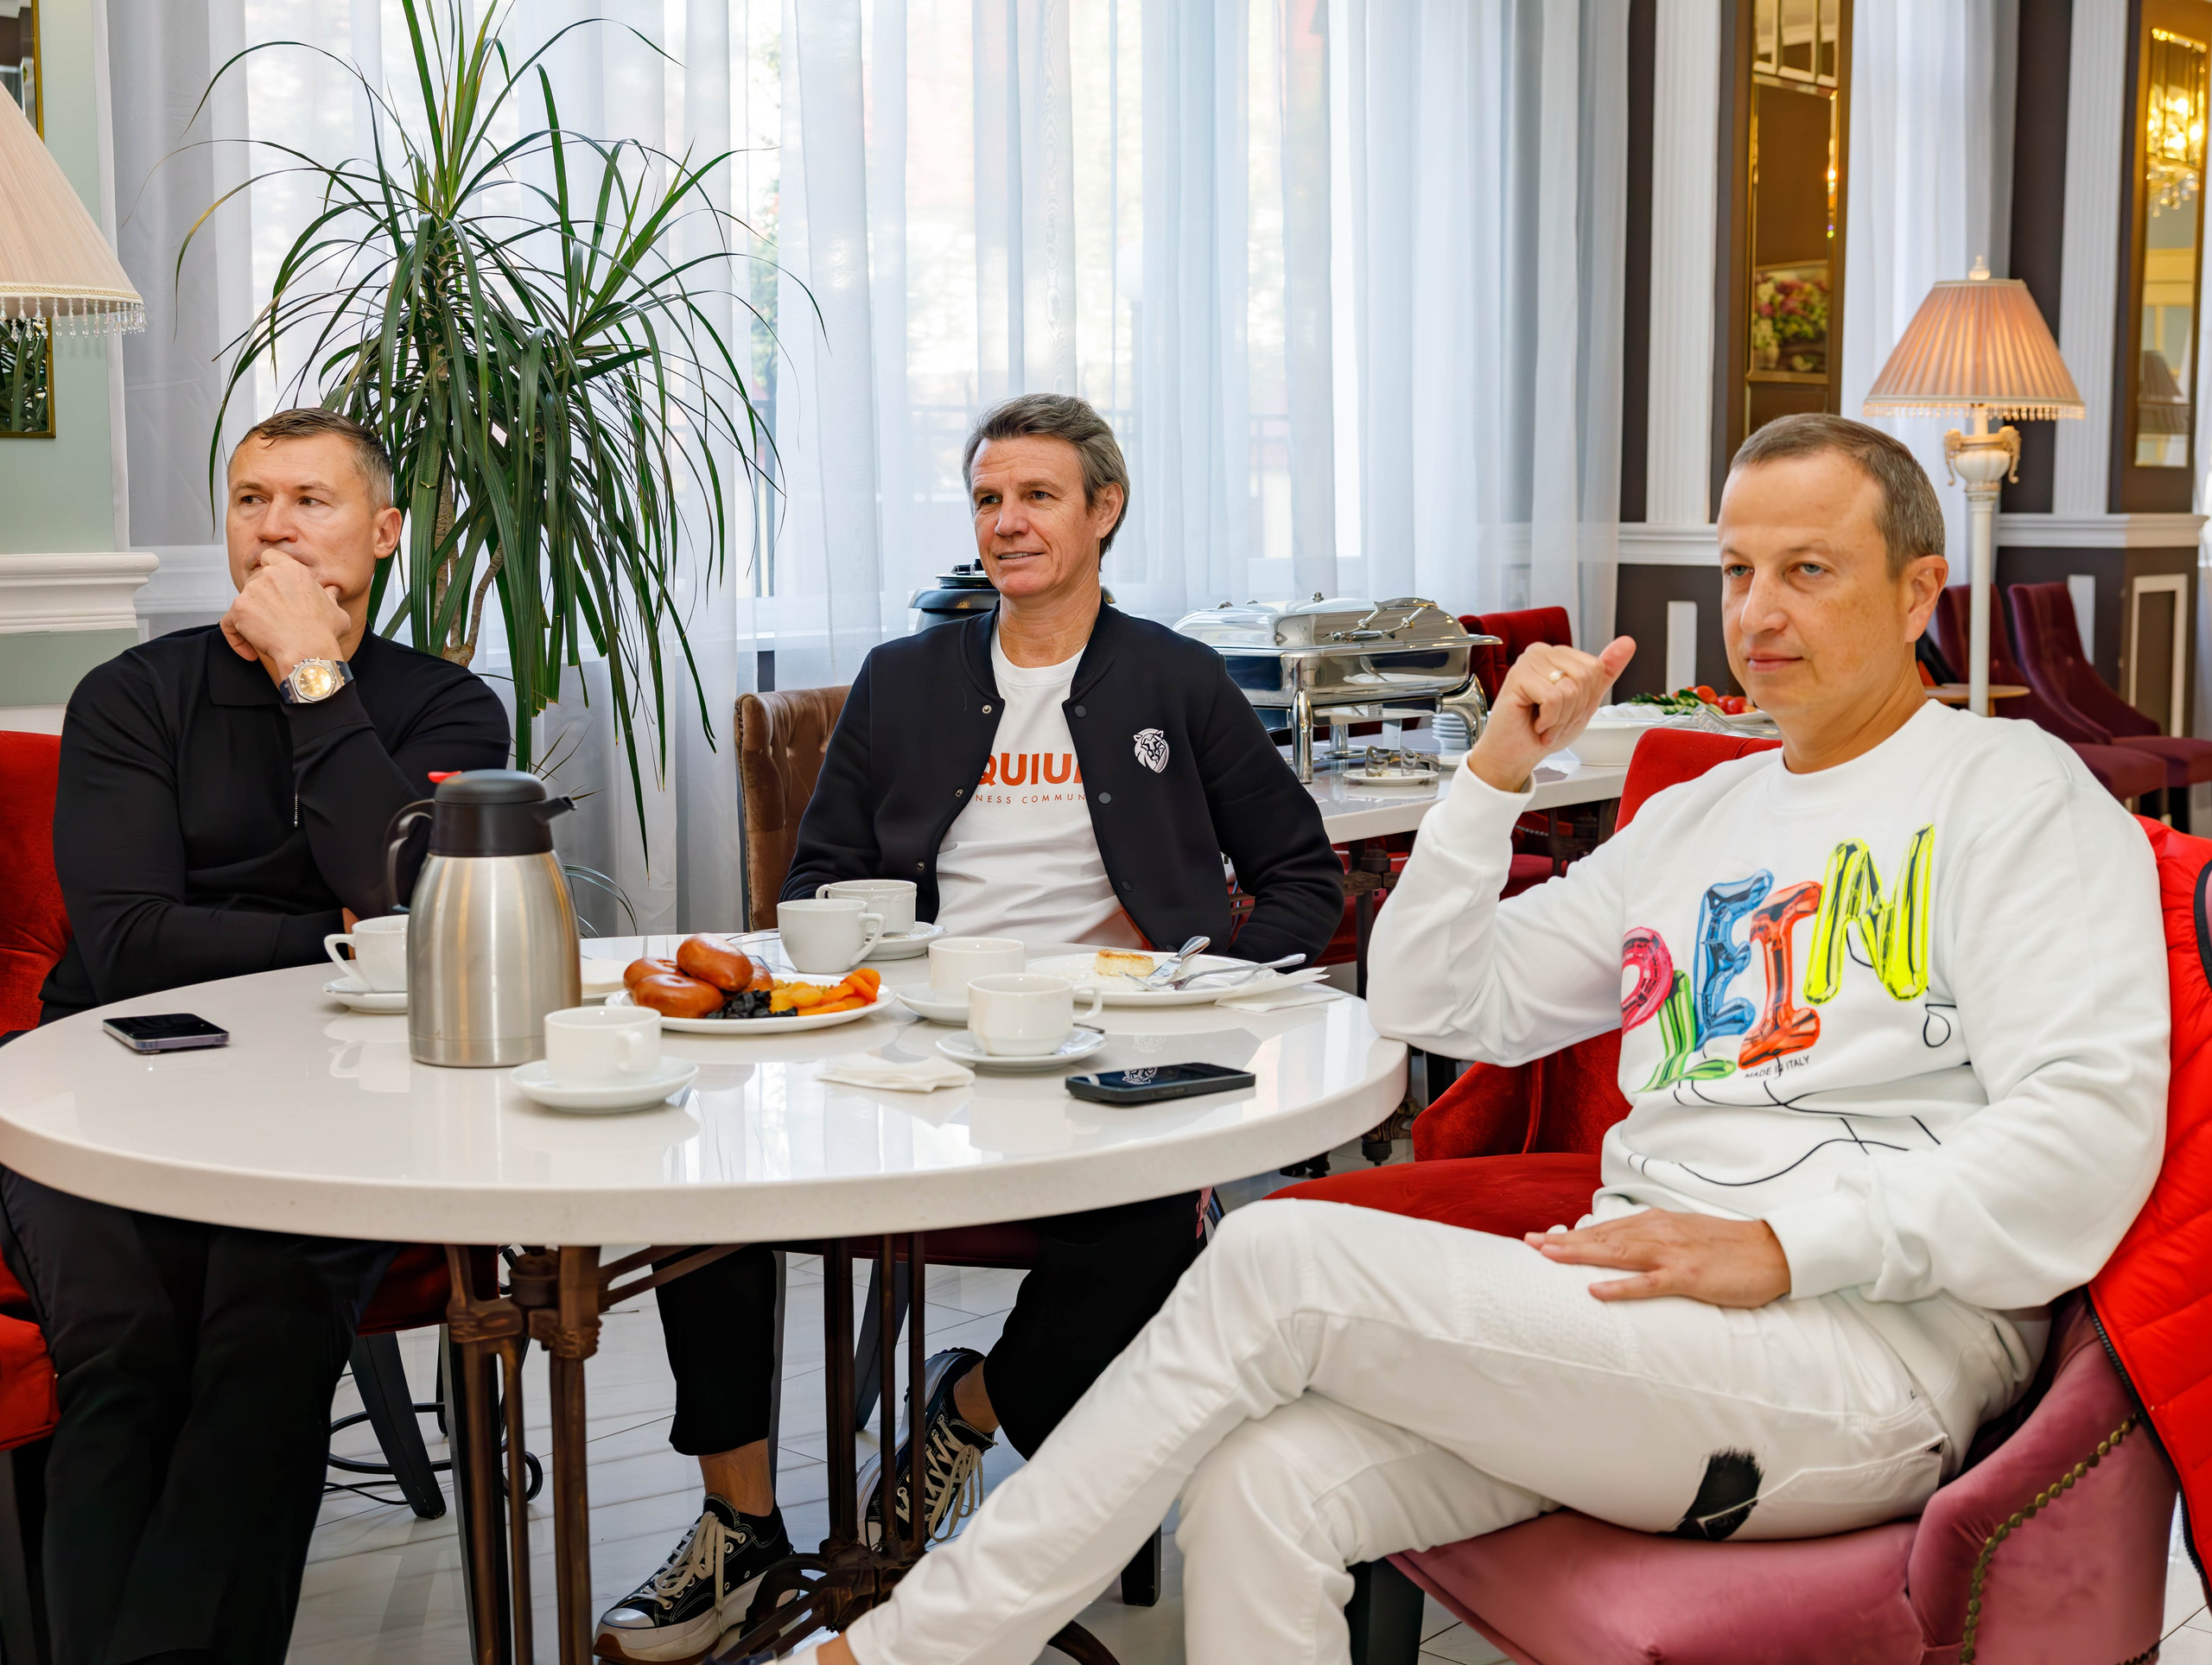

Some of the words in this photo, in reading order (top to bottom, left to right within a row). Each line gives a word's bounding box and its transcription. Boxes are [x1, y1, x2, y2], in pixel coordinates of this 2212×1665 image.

[975, 794, 1012, 804] NESS
[1021, 793, 1086, 804] COMMUN
[1744, 1067, 1771, 1078] MADE
[1786, 1055, 1810, 1071] ITALY
